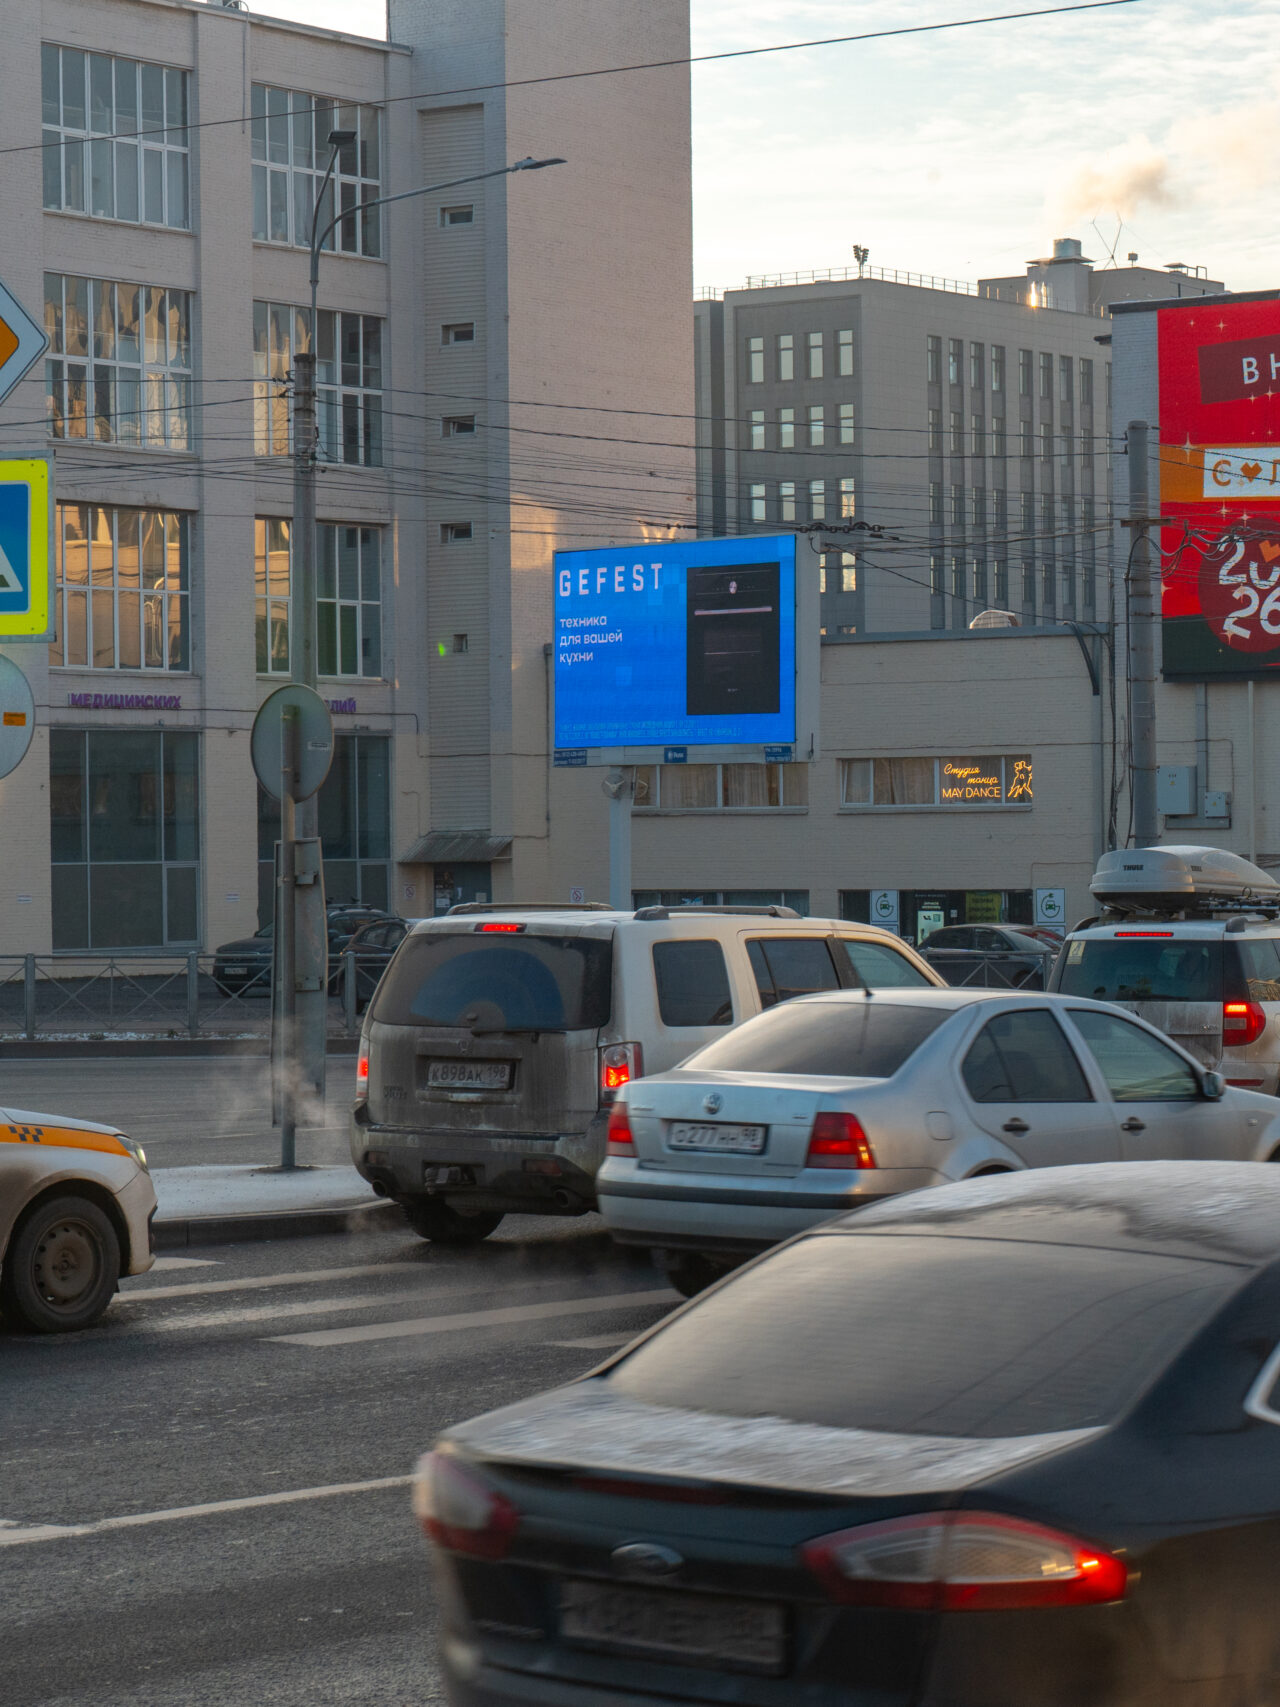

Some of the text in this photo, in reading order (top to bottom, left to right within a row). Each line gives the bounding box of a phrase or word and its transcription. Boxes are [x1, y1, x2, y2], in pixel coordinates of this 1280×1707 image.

[1242, 356, 1260, 385] В
[1212, 459, 1232, 487] С
[559, 563, 663, 597] GEFEST
[559, 616, 608, 628] техника
[559, 629, 623, 647] для вашей
[559, 652, 594, 666] кухни
[69, 692, 182, 710] МЕДИЦИНСКИХ
[943, 763, 981, 779] Студия
[966, 776, 1000, 786] танца
[942, 786, 1002, 799] MAY DANCE
